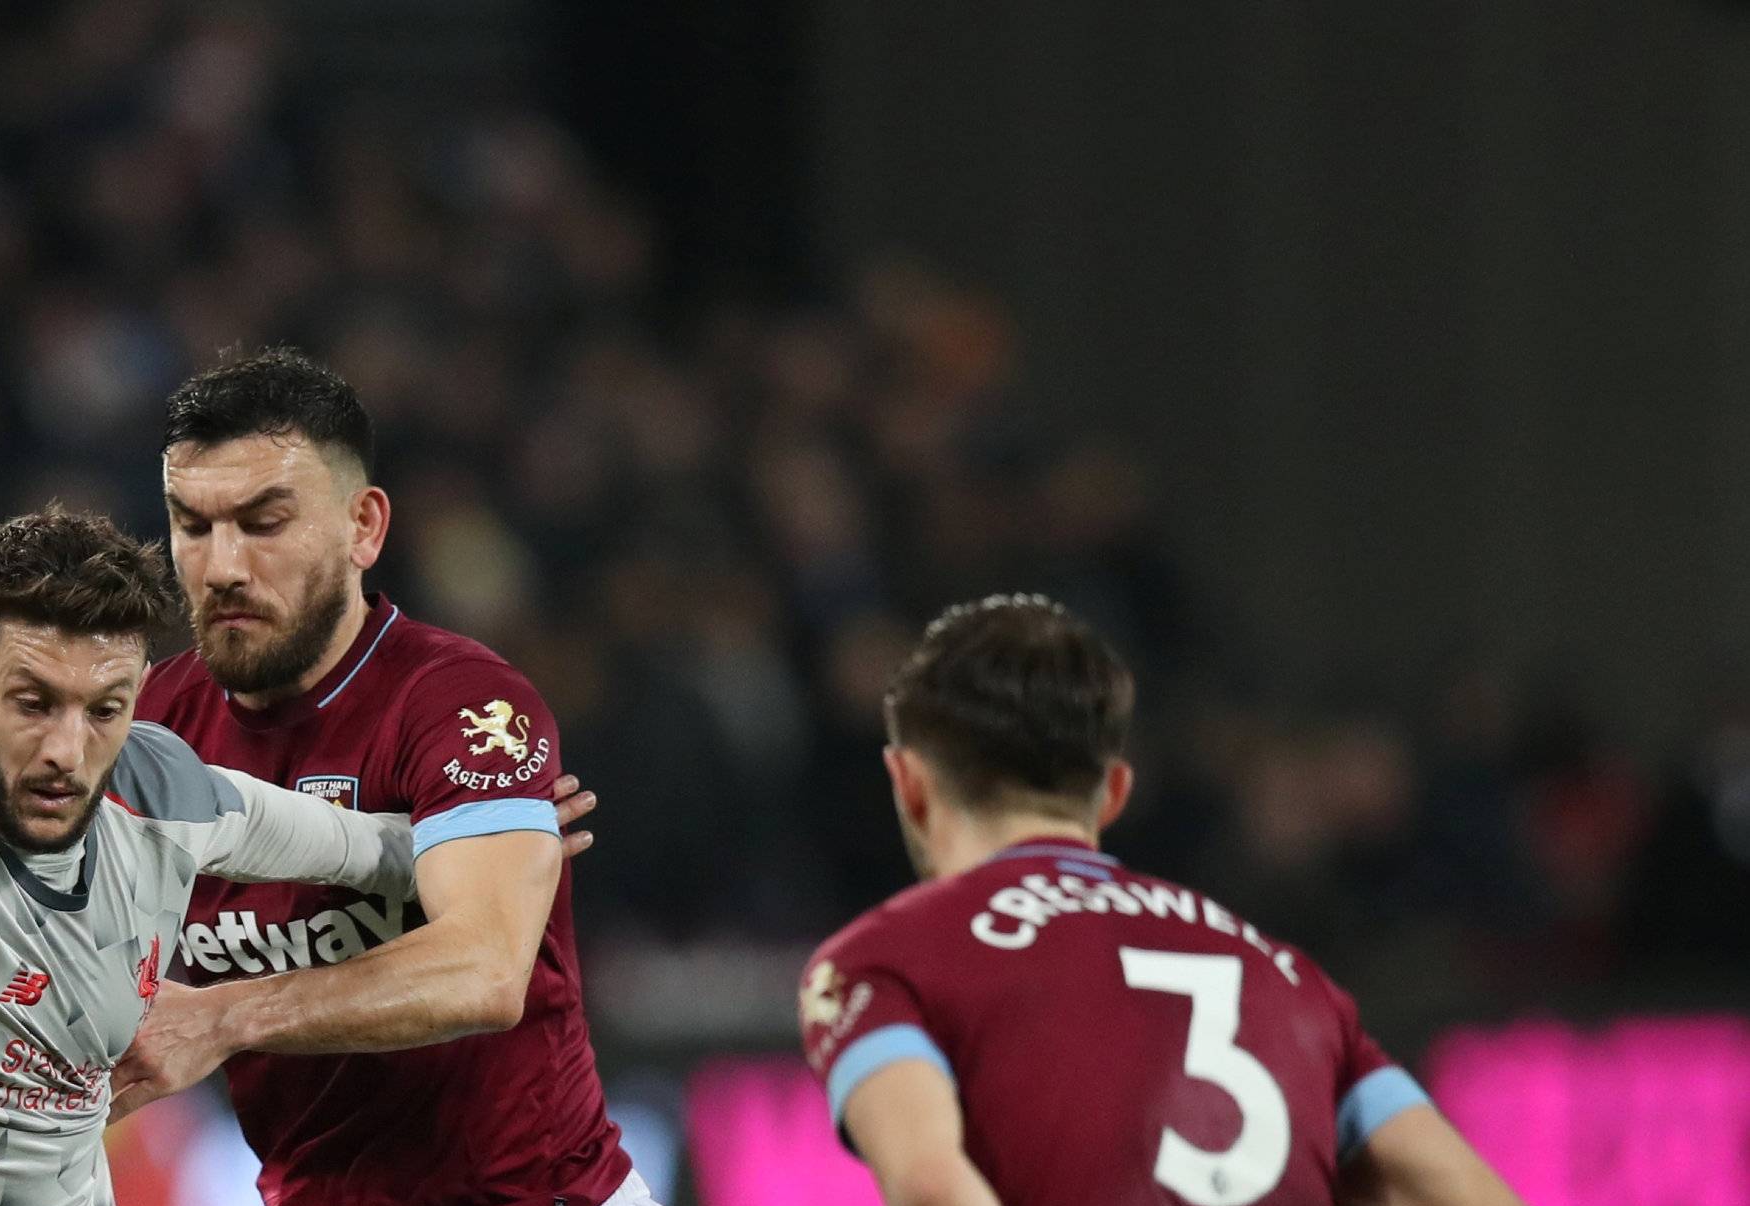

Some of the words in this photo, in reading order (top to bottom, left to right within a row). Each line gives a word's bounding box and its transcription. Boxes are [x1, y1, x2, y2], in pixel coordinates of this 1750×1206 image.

[302, 781, 329, 792] WEST
[329, 781, 352, 791] HAM
[496, 772, 513, 788] &
[515, 738, 549, 782] GOLD
[178, 898, 404, 974] etway
